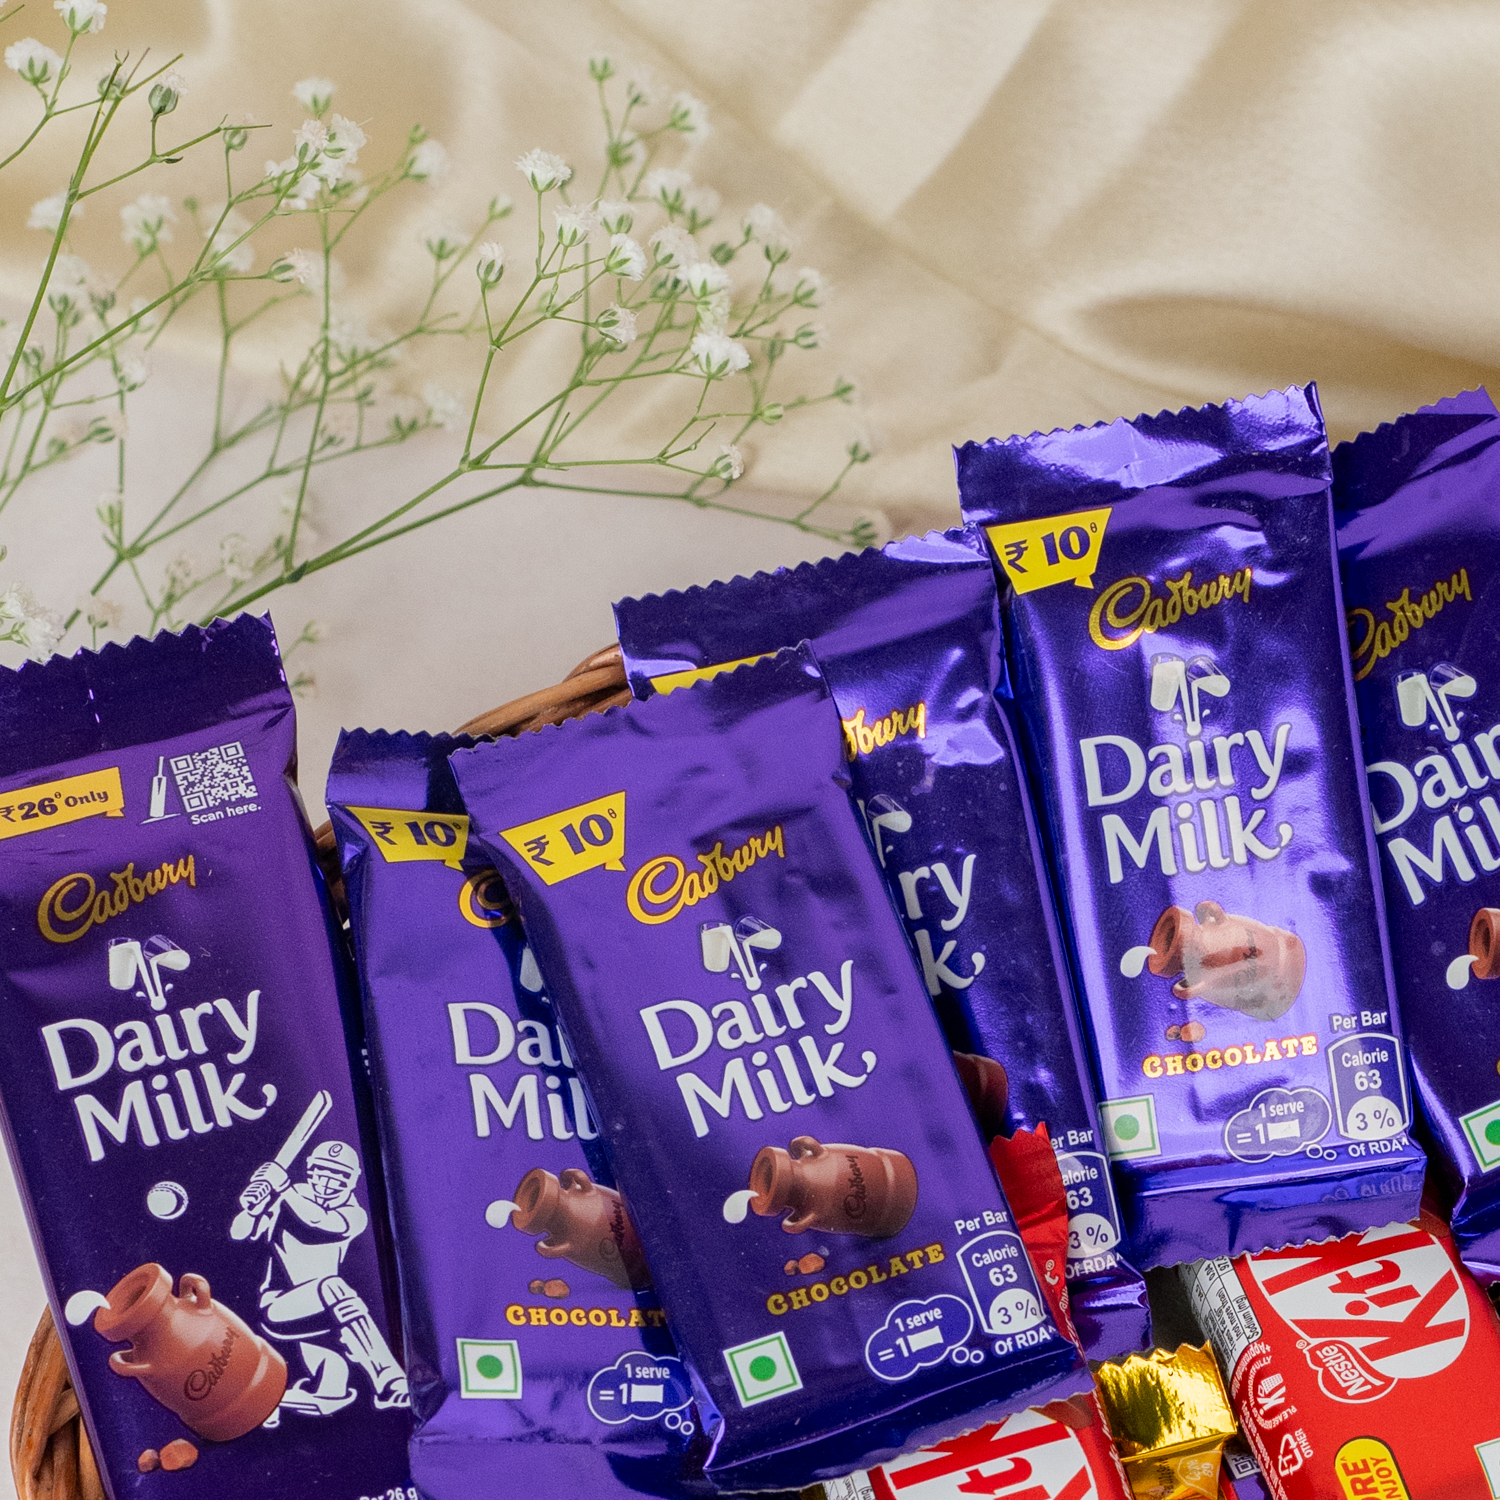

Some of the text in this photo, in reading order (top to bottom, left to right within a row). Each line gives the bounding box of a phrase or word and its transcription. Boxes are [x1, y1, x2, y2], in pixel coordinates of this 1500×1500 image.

[1088, 566, 1252, 651] Cadbury
[842, 699, 926, 760] dbury
[1079, 722, 1293, 807] Dairy
[65, 791, 109, 807] Only
[191, 803, 261, 825] Scan here.
[1102, 793, 1293, 885] Milk
[627, 826, 784, 925] Cadbury
[38, 855, 195, 943] Cadbury
[640, 960, 854, 1070] Dairy
[1332, 1011, 1388, 1031] Per Bar
[41, 990, 261, 1091] Dairy
[447, 1001, 574, 1068] Dai
[1142, 1036, 1318, 1078] CHOCOLATE
[1341, 1049, 1389, 1067] Calorie
[676, 1036, 876, 1138] Milk
[1354, 1069, 1382, 1091] 63
[74, 1063, 278, 1162] Milk
[469, 1073, 600, 1141] Mil
[1269, 1100, 1305, 1117] serve
[1050, 1128, 1093, 1150] er Bar
[1348, 1143, 1365, 1158] Of
[1063, 1166, 1098, 1186] alorie
[1066, 1187, 1093, 1209] 63
[954, 1209, 1007, 1234] Per Bar
[971, 1242, 1018, 1268] Calorie
[767, 1243, 945, 1315] CHOCOLATE
[989, 1264, 1017, 1286] 63
[506, 1305, 667, 1327] CHOCOLAT
[906, 1306, 942, 1325] serve
[1240, 1310, 1259, 1339] Sodium
[995, 1340, 1012, 1356] Of
[184, 1324, 240, 1401] Cadbury
[634, 1364, 670, 1379] serve
[1293, 1426, 1313, 1459] OTHER
